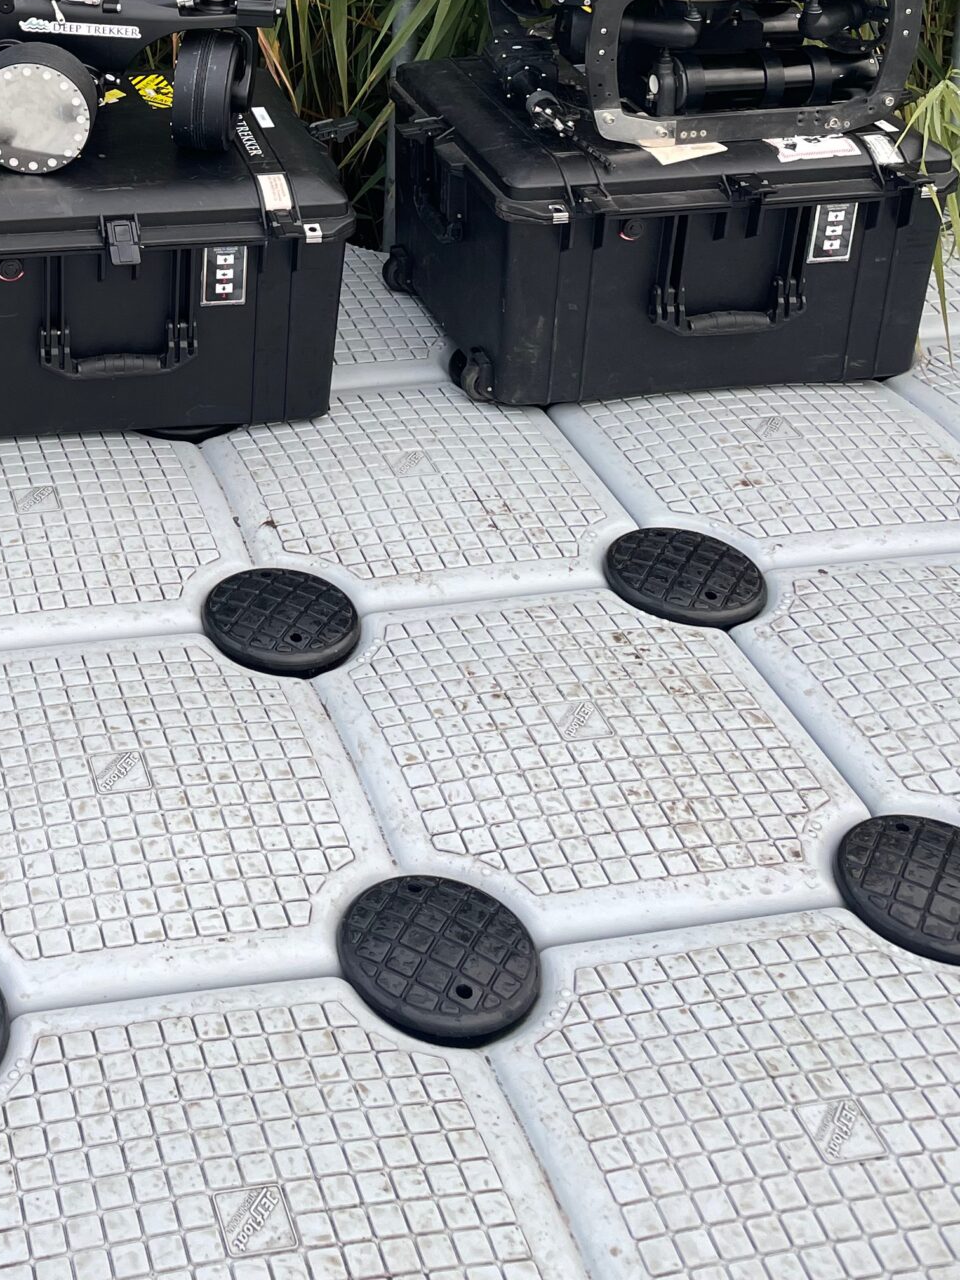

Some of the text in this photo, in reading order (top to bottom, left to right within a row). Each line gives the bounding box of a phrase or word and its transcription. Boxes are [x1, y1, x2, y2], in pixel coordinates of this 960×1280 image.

[52, 22, 140, 38] DEEP TREKKER
[235, 120, 264, 158] TREKKER
